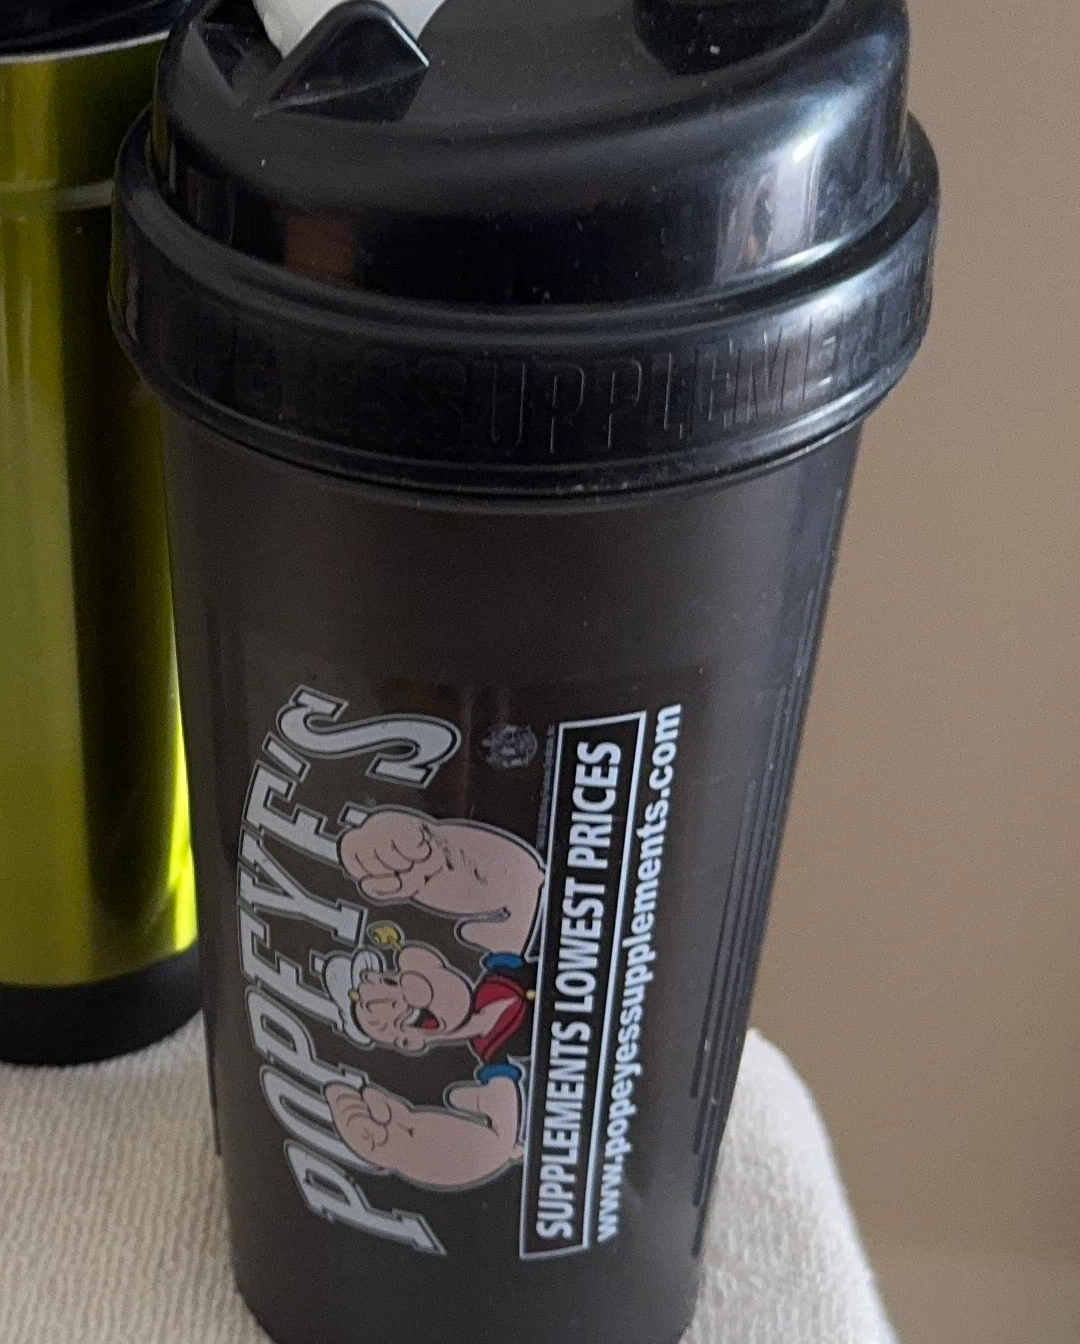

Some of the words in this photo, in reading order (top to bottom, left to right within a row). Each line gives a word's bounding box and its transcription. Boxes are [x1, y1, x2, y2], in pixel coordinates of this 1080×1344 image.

[567, 741, 622, 869] PRICES
[237, 685, 461, 1255] POPEYE'S
[554, 877, 605, 1014] LOWEST
[597, 704, 682, 1243] www.popeyessupplements.com
[535, 1021, 590, 1239] SUPPLEMENTS
